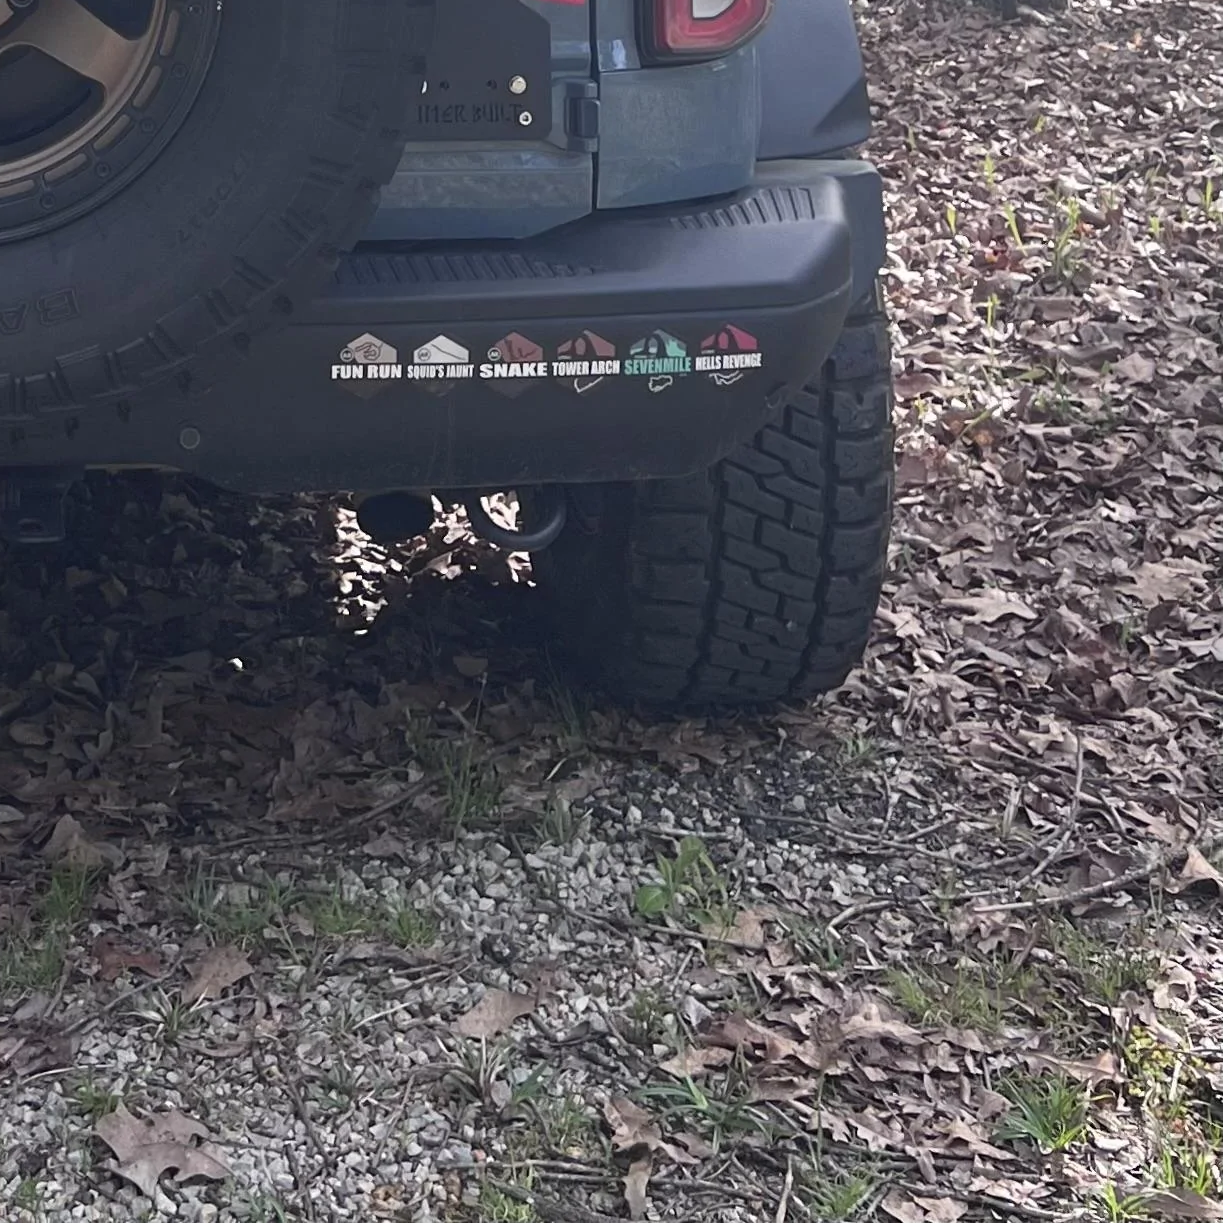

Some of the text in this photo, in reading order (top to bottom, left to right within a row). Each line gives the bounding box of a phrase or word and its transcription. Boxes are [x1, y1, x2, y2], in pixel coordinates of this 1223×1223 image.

[479, 362, 548, 377] SNAKE
[552, 360, 621, 376] TOWER ARCH
[624, 357, 692, 376] SEVENMILE
[695, 353, 762, 371] HELLS REVENGE
[332, 364, 402, 379] FUN RUN
[407, 364, 475, 380] SQUID'S JAUNT
